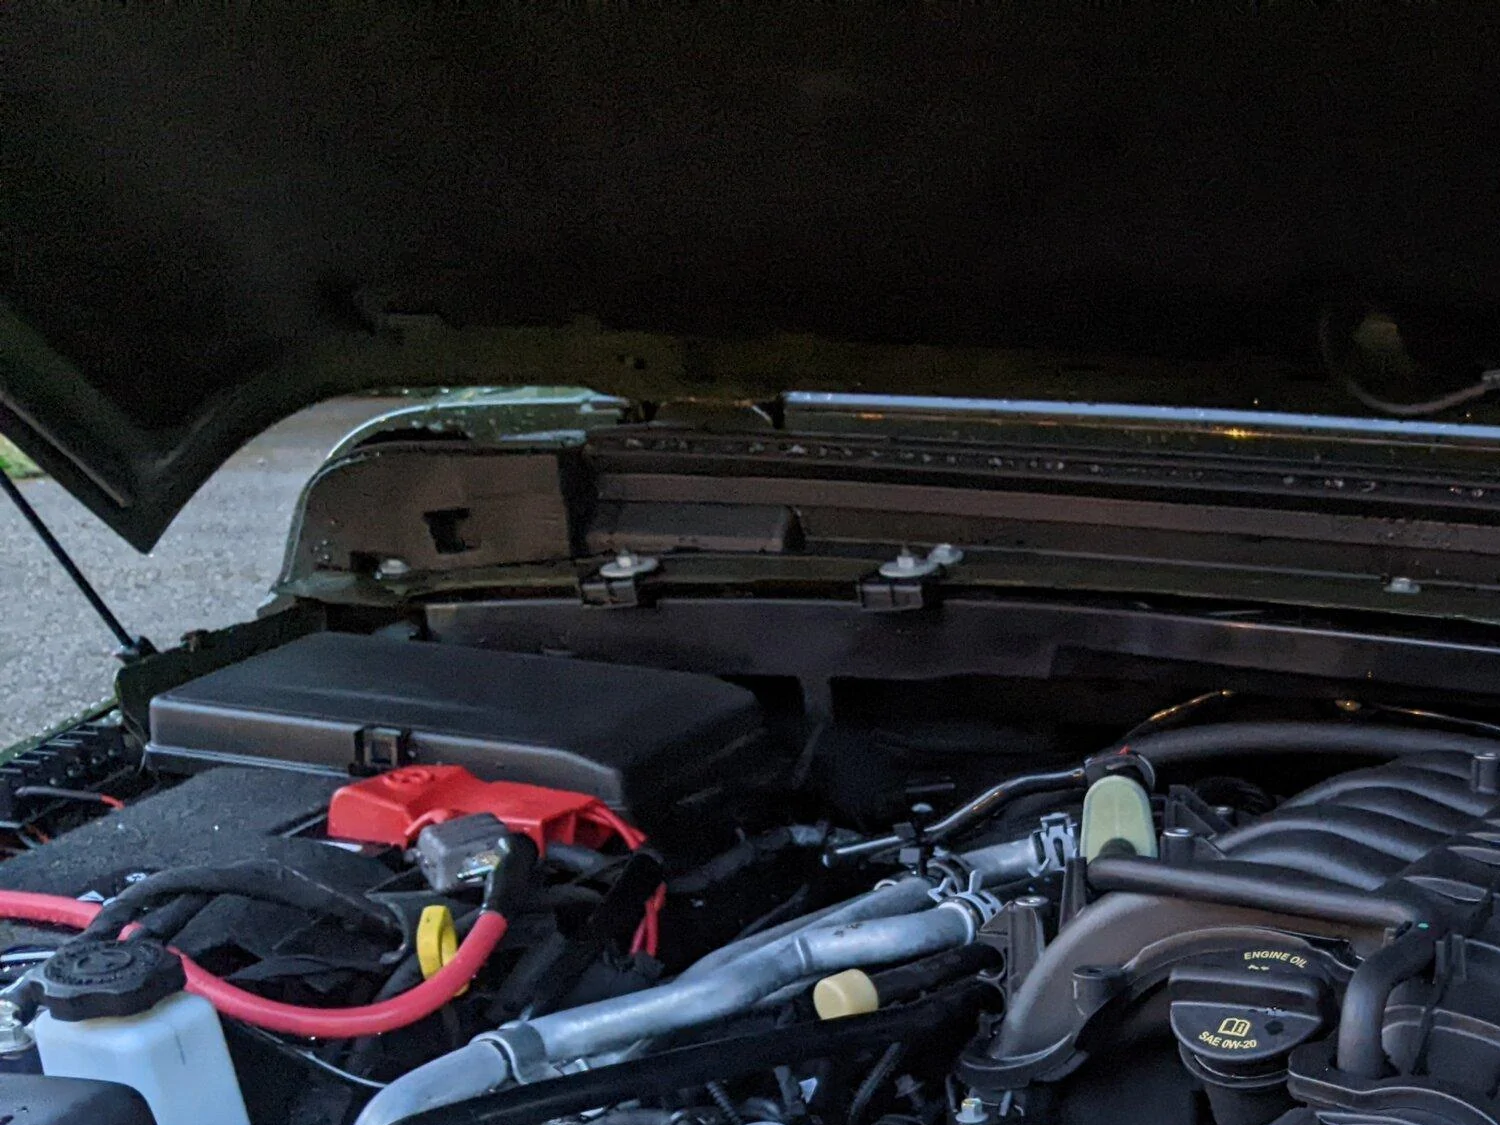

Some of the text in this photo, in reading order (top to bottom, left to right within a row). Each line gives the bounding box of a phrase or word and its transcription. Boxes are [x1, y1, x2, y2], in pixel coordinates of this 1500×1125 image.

[1244, 951, 1308, 968] ENGINE OIL
[1199, 1031, 1258, 1050] SAE 0W-20
